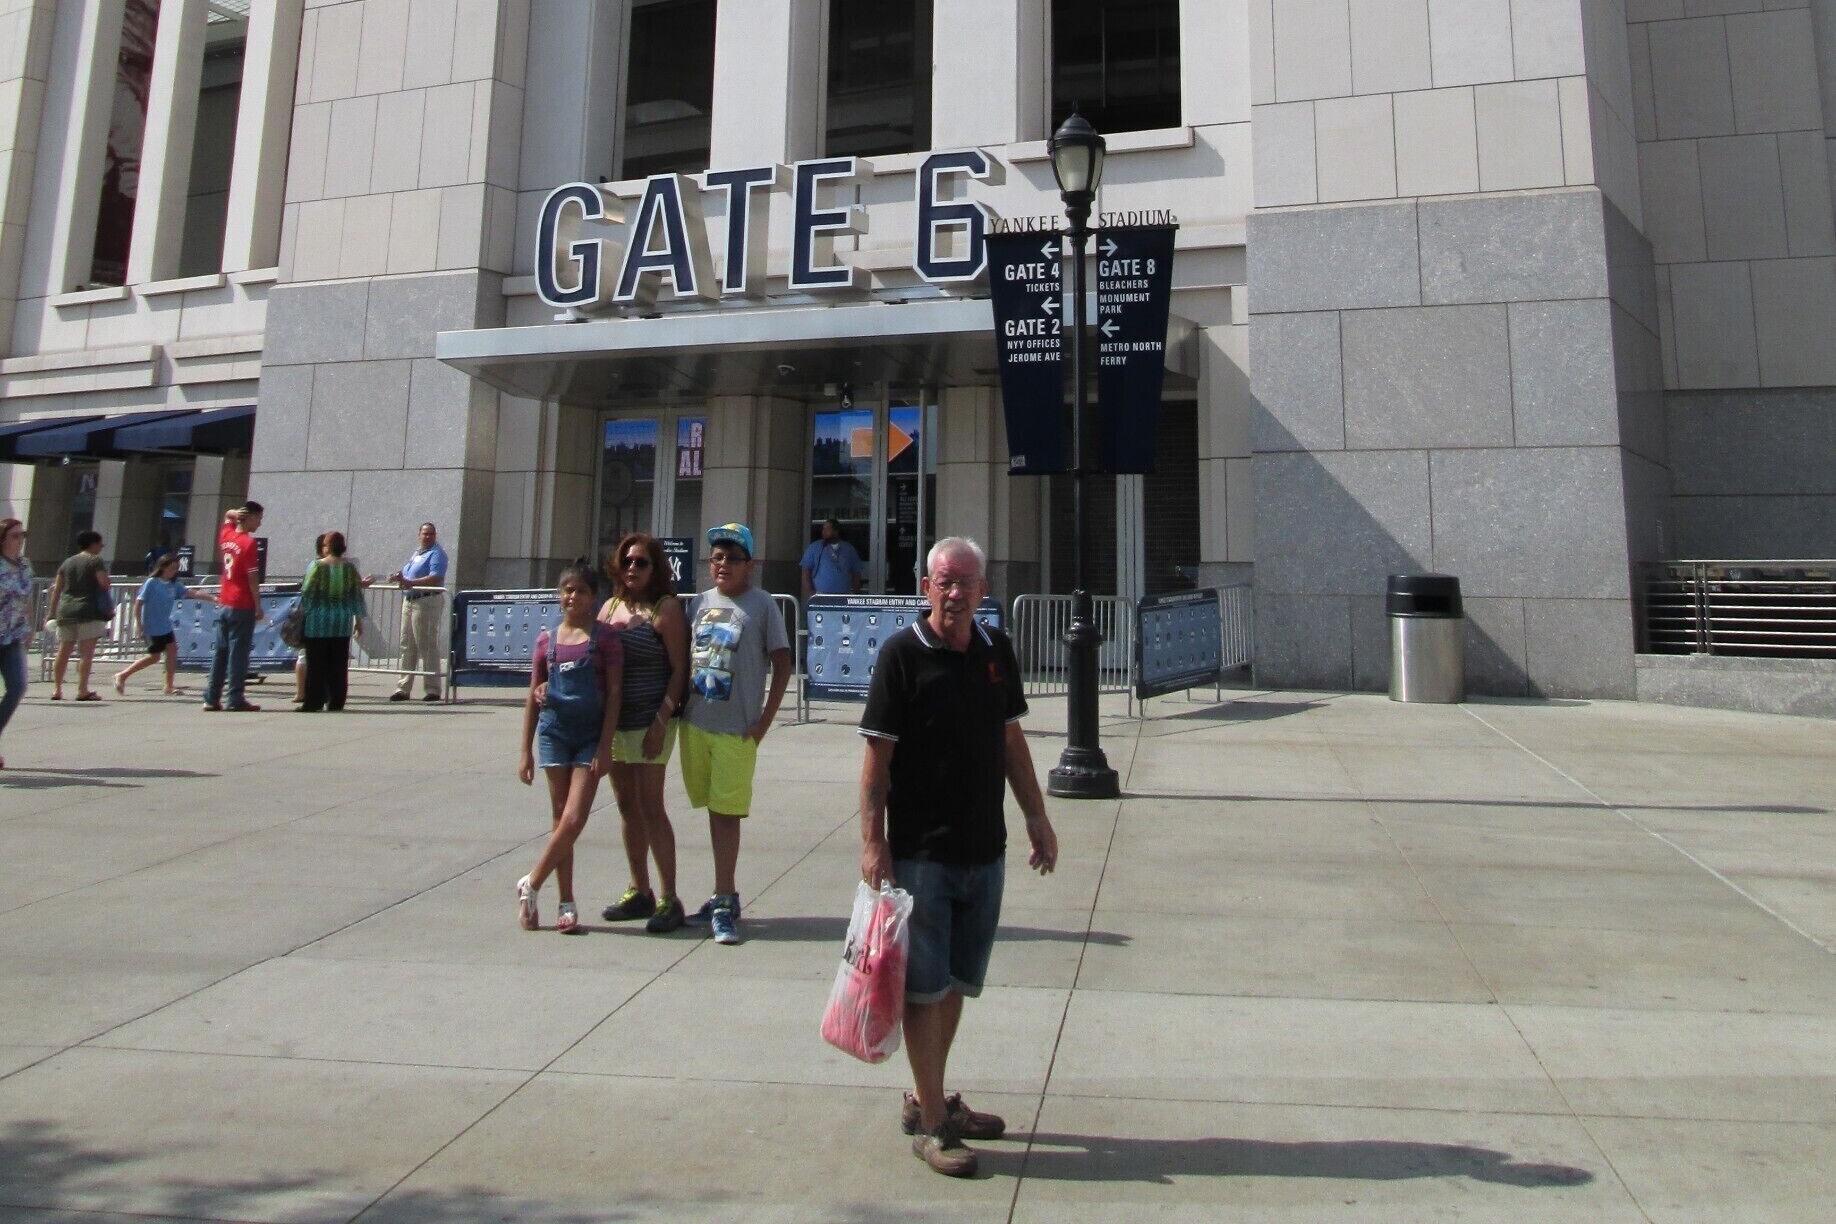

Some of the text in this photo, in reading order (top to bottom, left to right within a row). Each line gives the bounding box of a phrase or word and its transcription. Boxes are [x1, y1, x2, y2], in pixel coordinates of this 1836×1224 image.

[991, 209, 1171, 233] YANKEE STADIUM
[534, 147, 993, 309] GATE 6
[1004, 262, 1060, 281] GATE 4
[1099, 258, 1156, 277] GATE 8
[1026, 282, 1060, 293] TICKETS
[1099, 279, 1149, 290] BLEACHERS
[1099, 292, 1150, 303] MONUMENT
[1099, 304, 1122, 314] PARK
[1004, 318, 1061, 337] GATE 2
[1007, 338, 1061, 350] NYY OFFICES
[1100, 341, 1162, 353] METRO NORTH
[1008, 351, 1061, 363] JEROME AVE
[1100, 356, 1127, 366] FERRY
[847, 598, 865, 606] YANKEE
[866, 598, 888, 606] STADIUM
